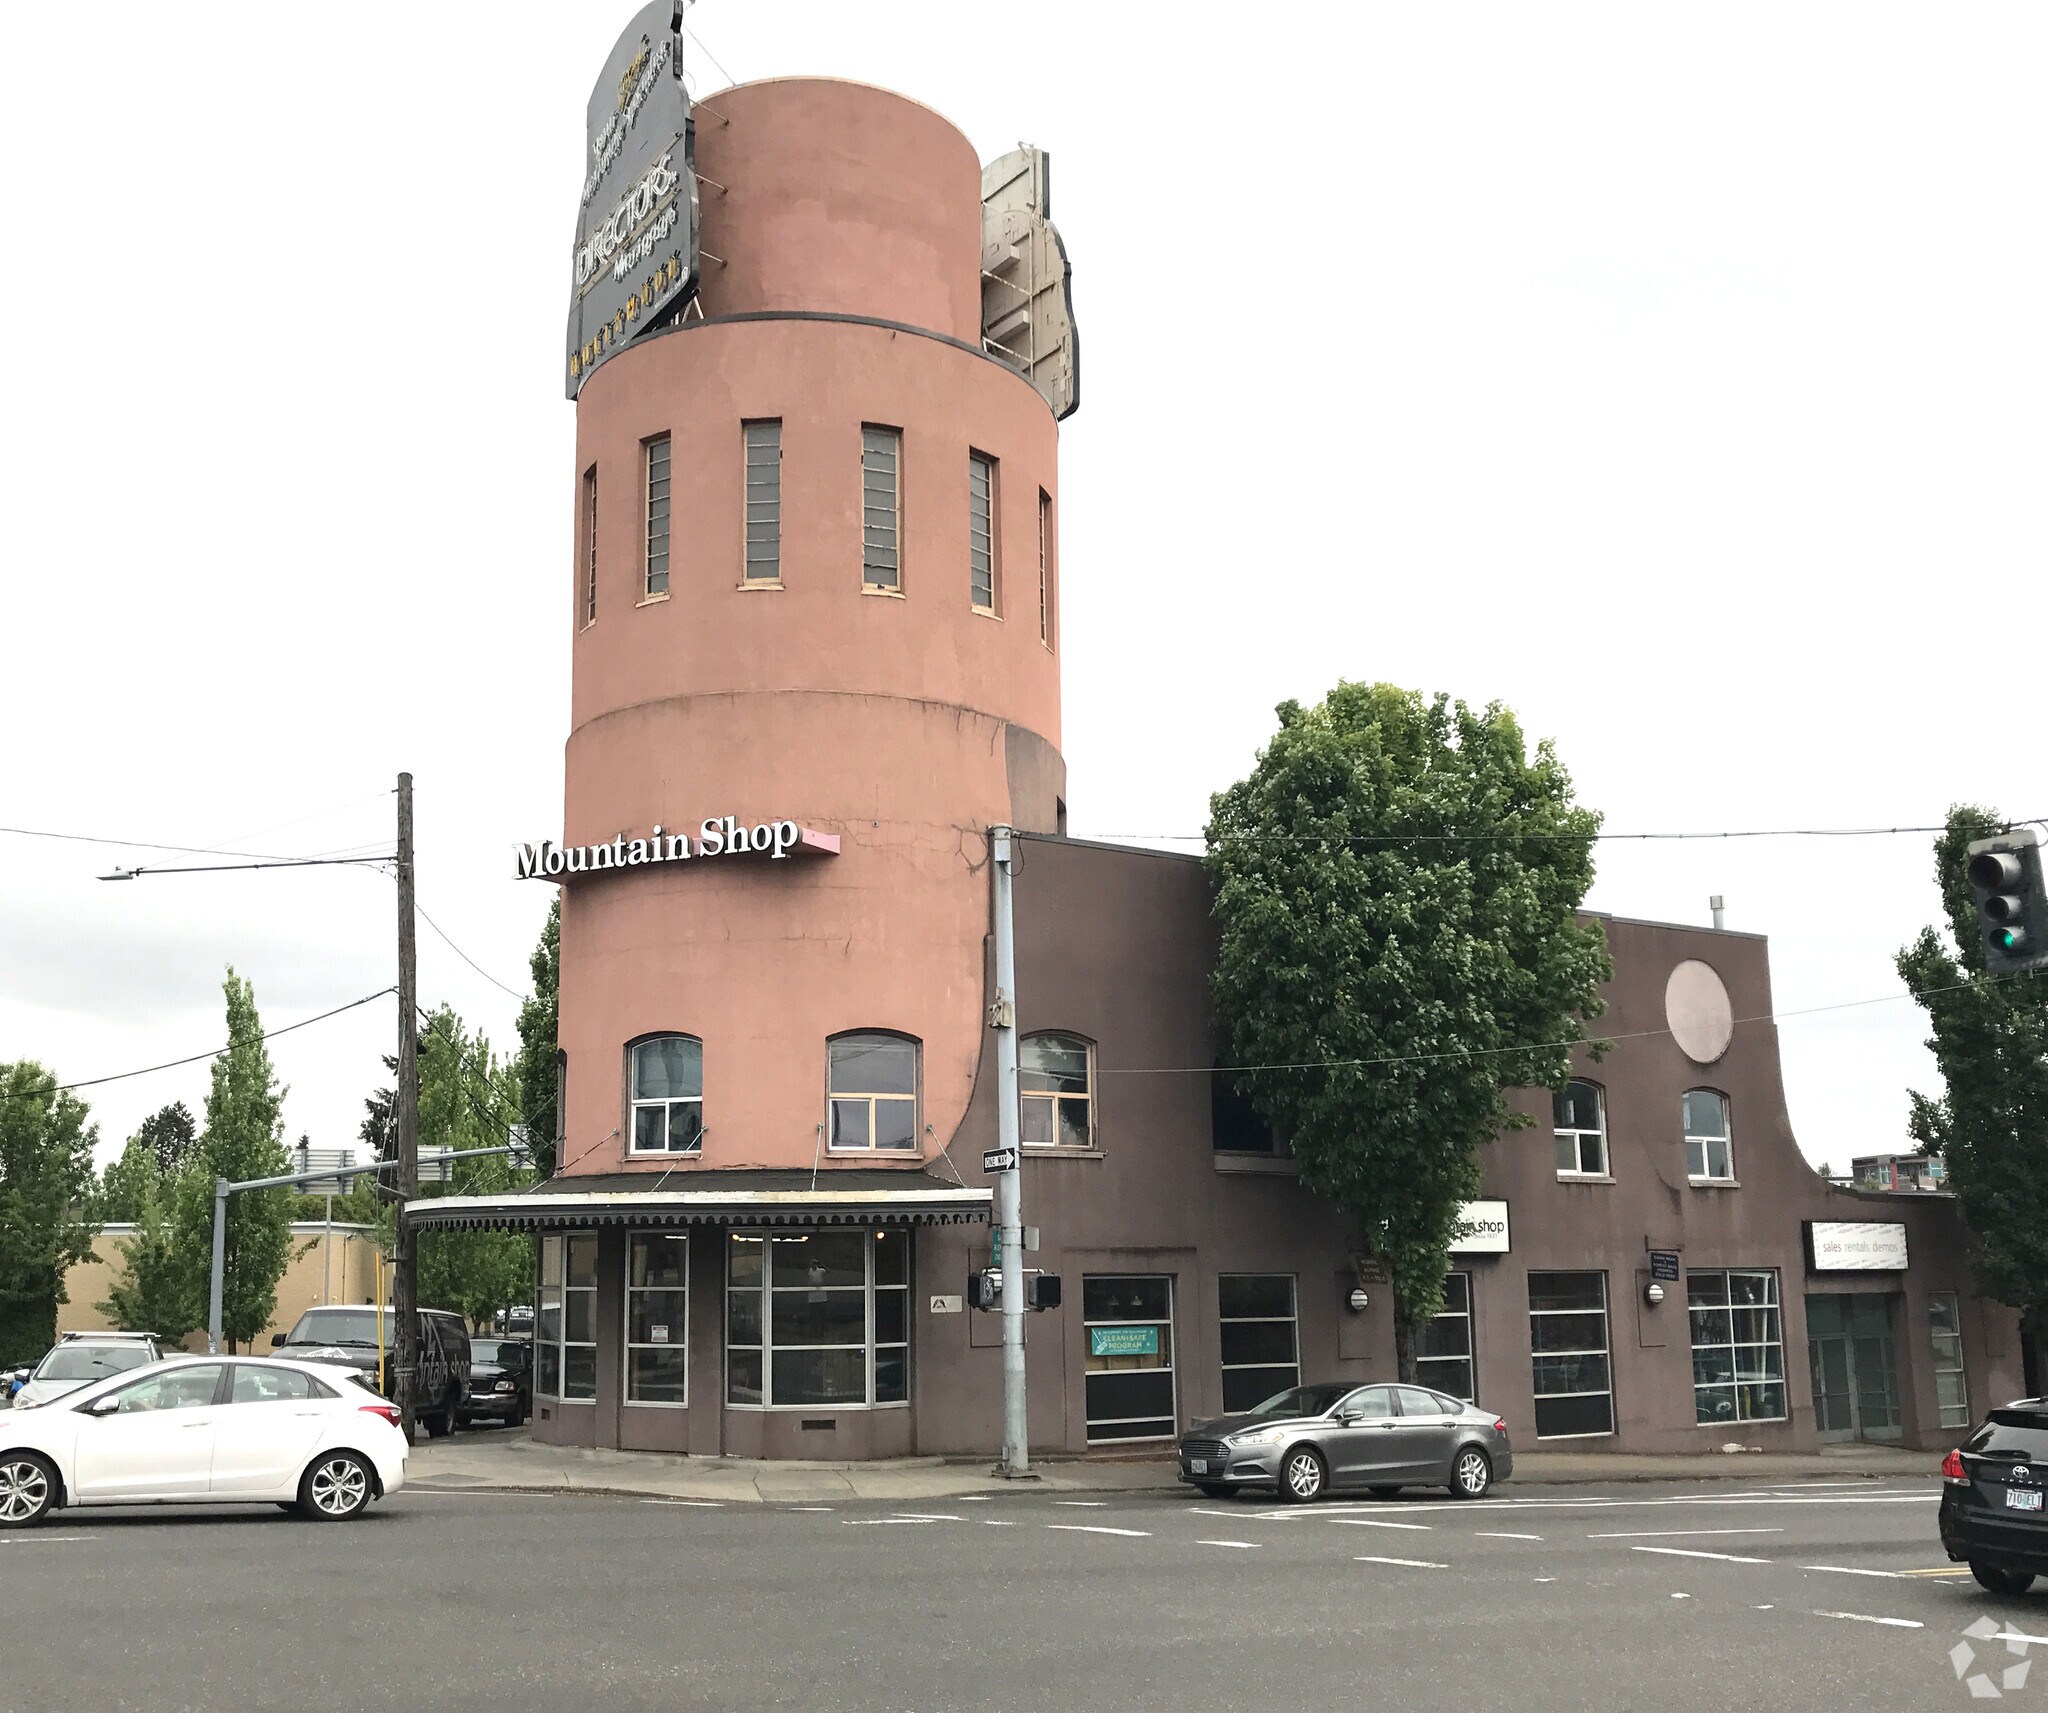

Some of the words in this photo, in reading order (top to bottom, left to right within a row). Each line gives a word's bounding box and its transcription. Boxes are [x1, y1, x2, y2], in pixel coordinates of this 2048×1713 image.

[576, 154, 679, 284] DIRECTORS
[511, 823, 693, 880] Mountain
[698, 815, 800, 860] Shop
[986, 1158, 996, 1167] ONE
[997, 1155, 1008, 1165] WAY
[1478, 1219, 1505, 1234] shop
[1823, 1241, 1842, 1253] sales
[1844, 1241, 1870, 1253] rentals
[1872, 1241, 1898, 1253] demos
